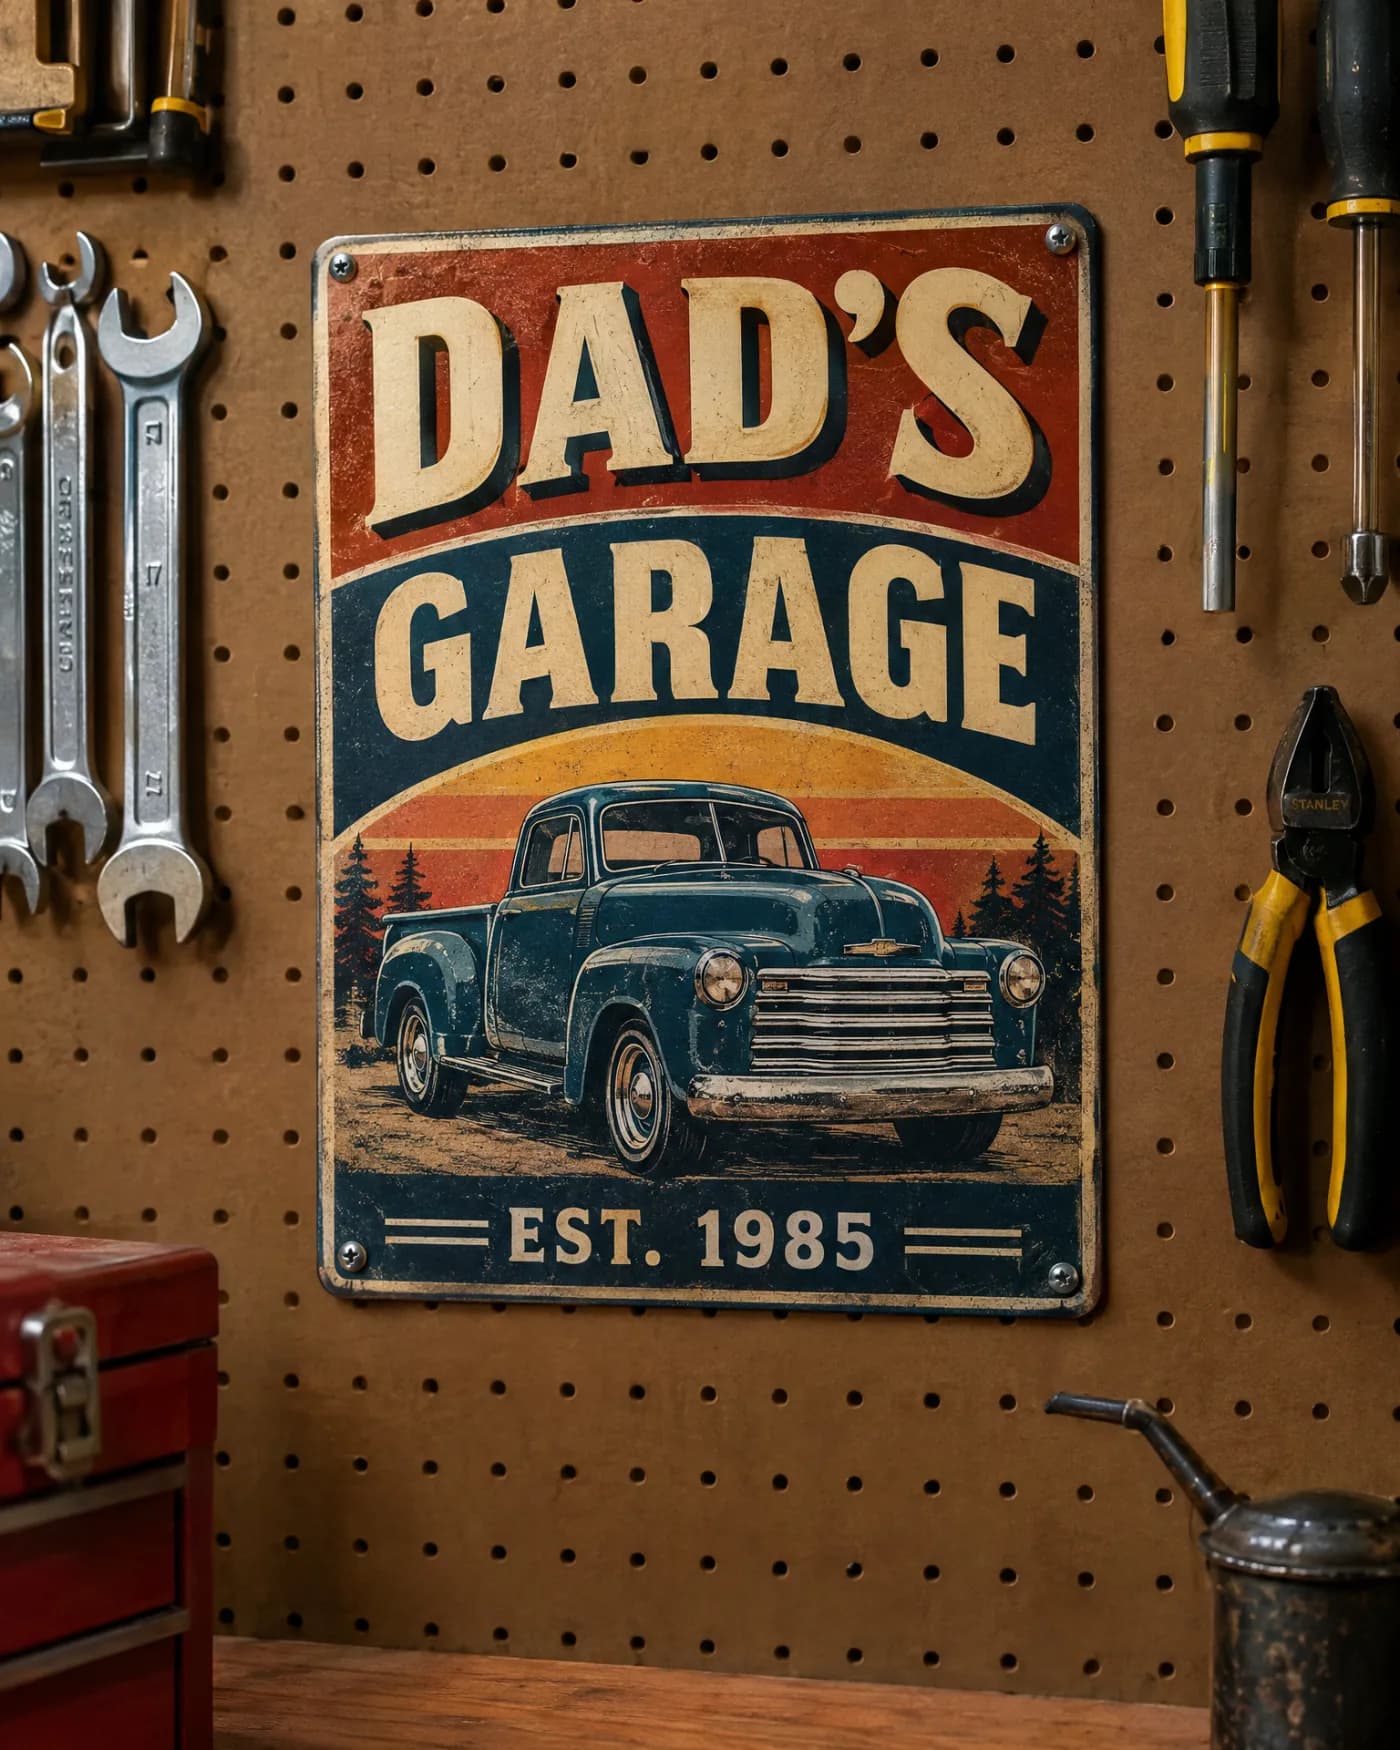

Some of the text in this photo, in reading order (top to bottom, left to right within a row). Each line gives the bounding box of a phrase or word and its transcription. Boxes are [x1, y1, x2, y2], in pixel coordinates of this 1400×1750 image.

[363, 267, 1044, 533] DAD'S
[373, 536, 1037, 746] GARAGE
[1291, 799, 1350, 811] STANLEY
[508, 1206, 874, 1271] EST. 1985
